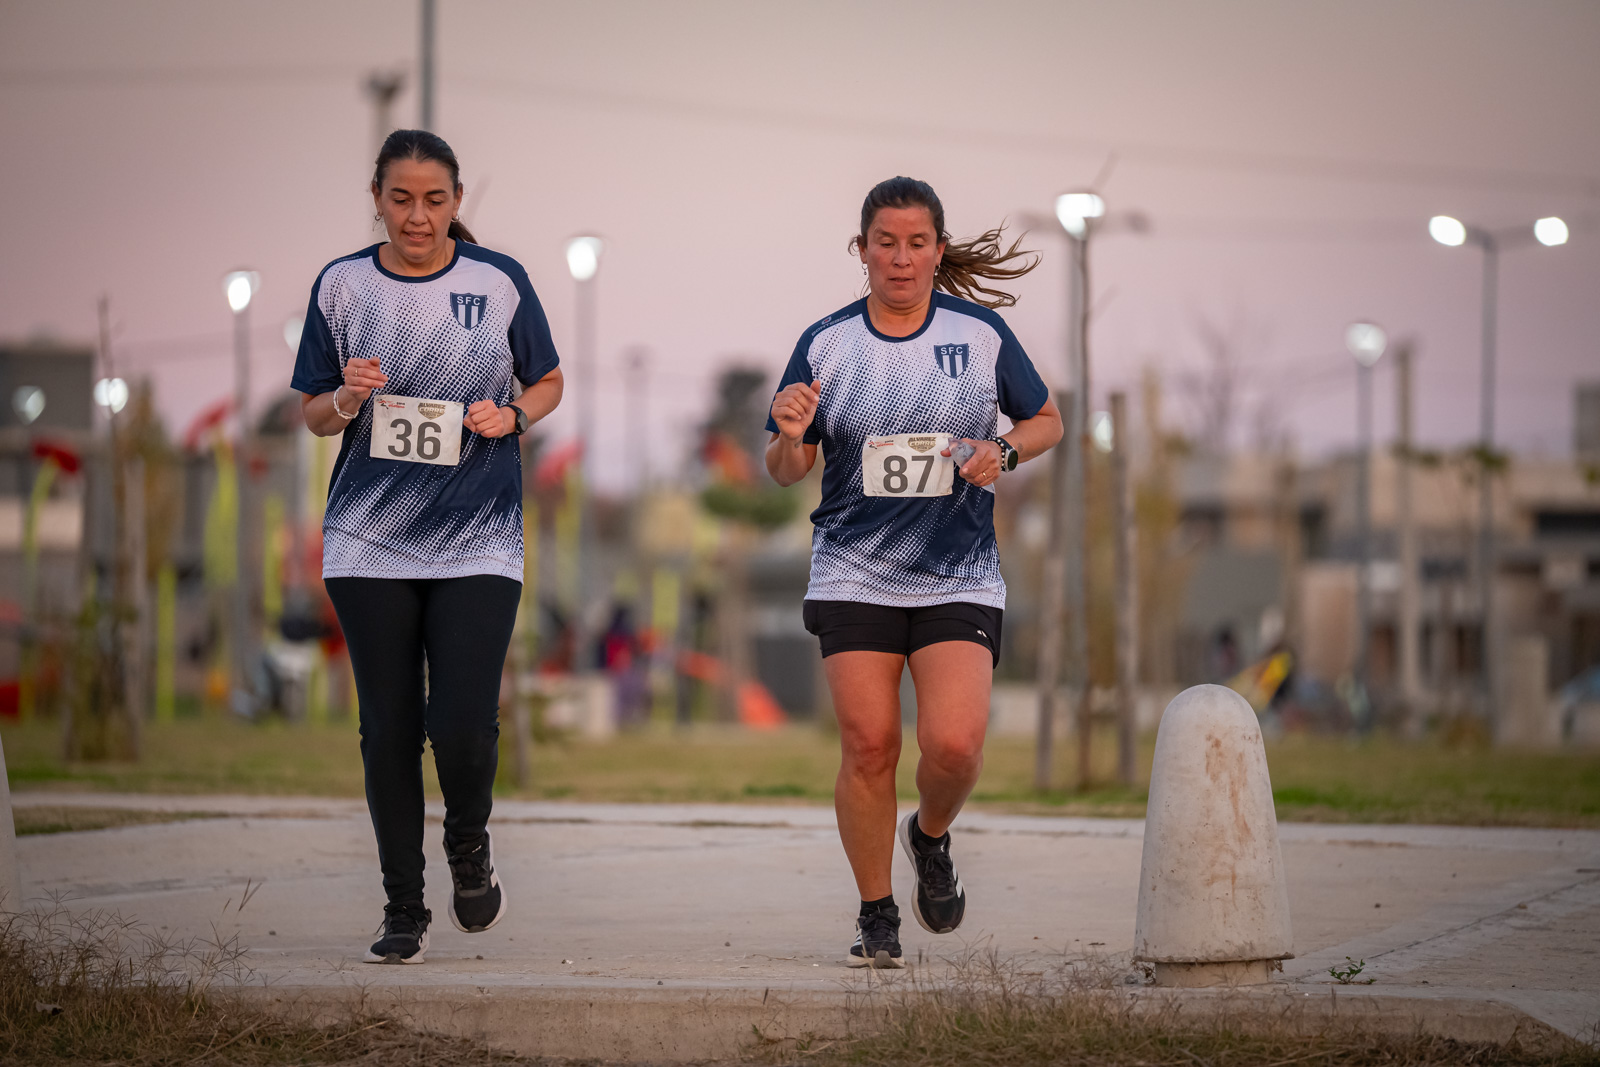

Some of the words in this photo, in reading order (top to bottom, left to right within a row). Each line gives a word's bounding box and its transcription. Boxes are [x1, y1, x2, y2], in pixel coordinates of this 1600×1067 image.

[457, 296, 480, 305] SFC
[940, 346, 963, 355] SFC
[388, 418, 441, 460] 36
[883, 455, 935, 494] 87
